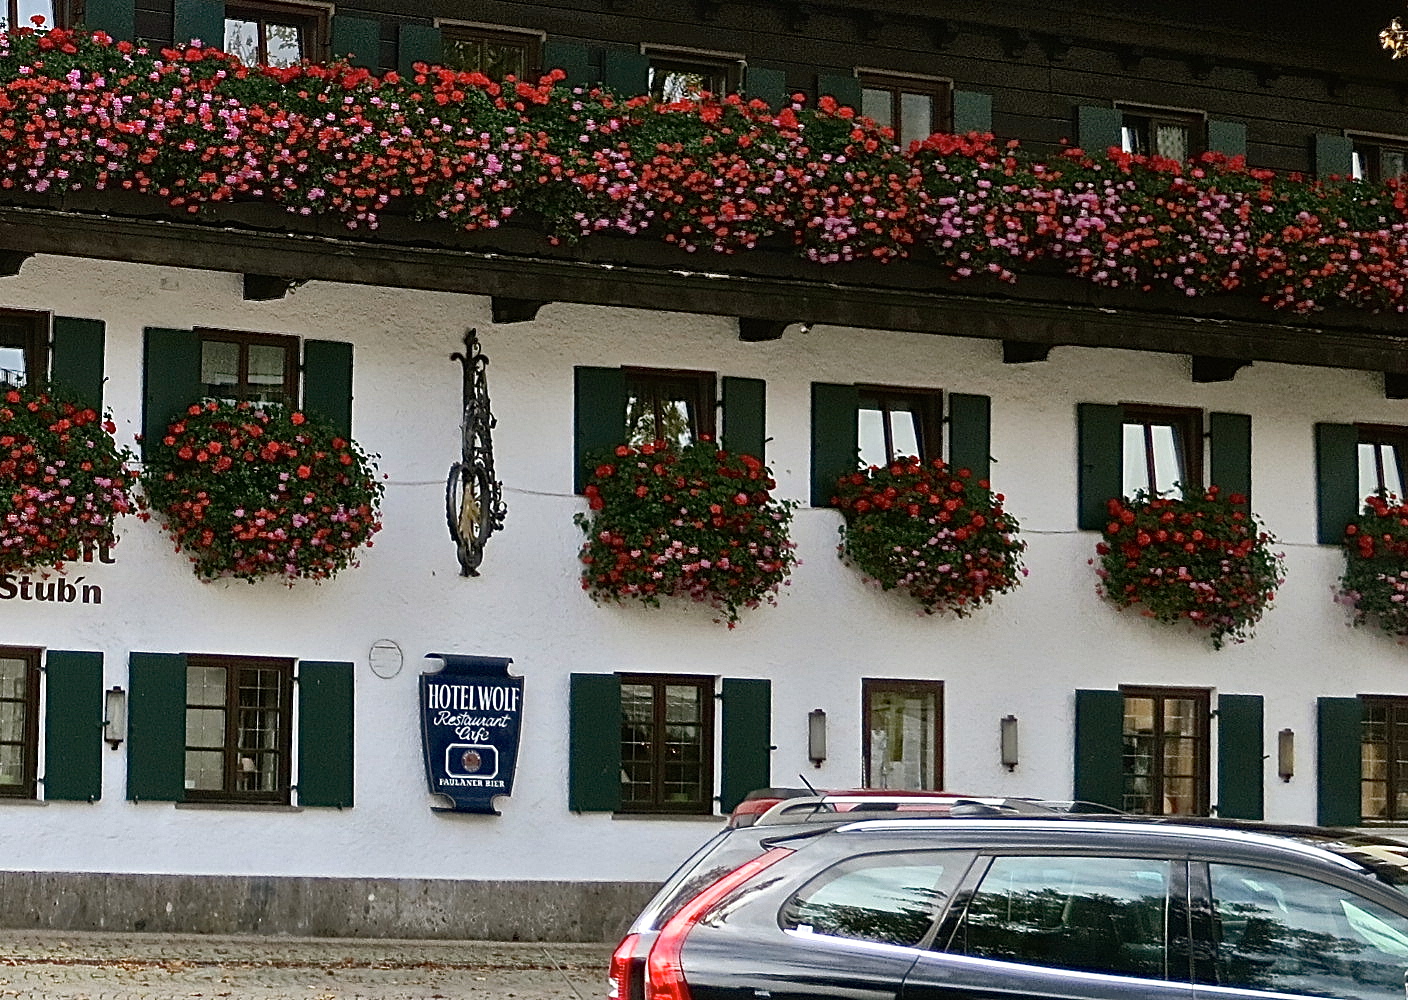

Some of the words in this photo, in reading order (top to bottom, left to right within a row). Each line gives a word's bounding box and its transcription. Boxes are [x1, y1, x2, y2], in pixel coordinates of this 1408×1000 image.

[428, 684, 476, 711] HOTEL
[477, 686, 520, 712] WOLF
[433, 710, 511, 728] Restaurant
[455, 726, 490, 744] Cafe
[439, 778, 483, 787] PAULANER
[485, 780, 505, 788] BIER
